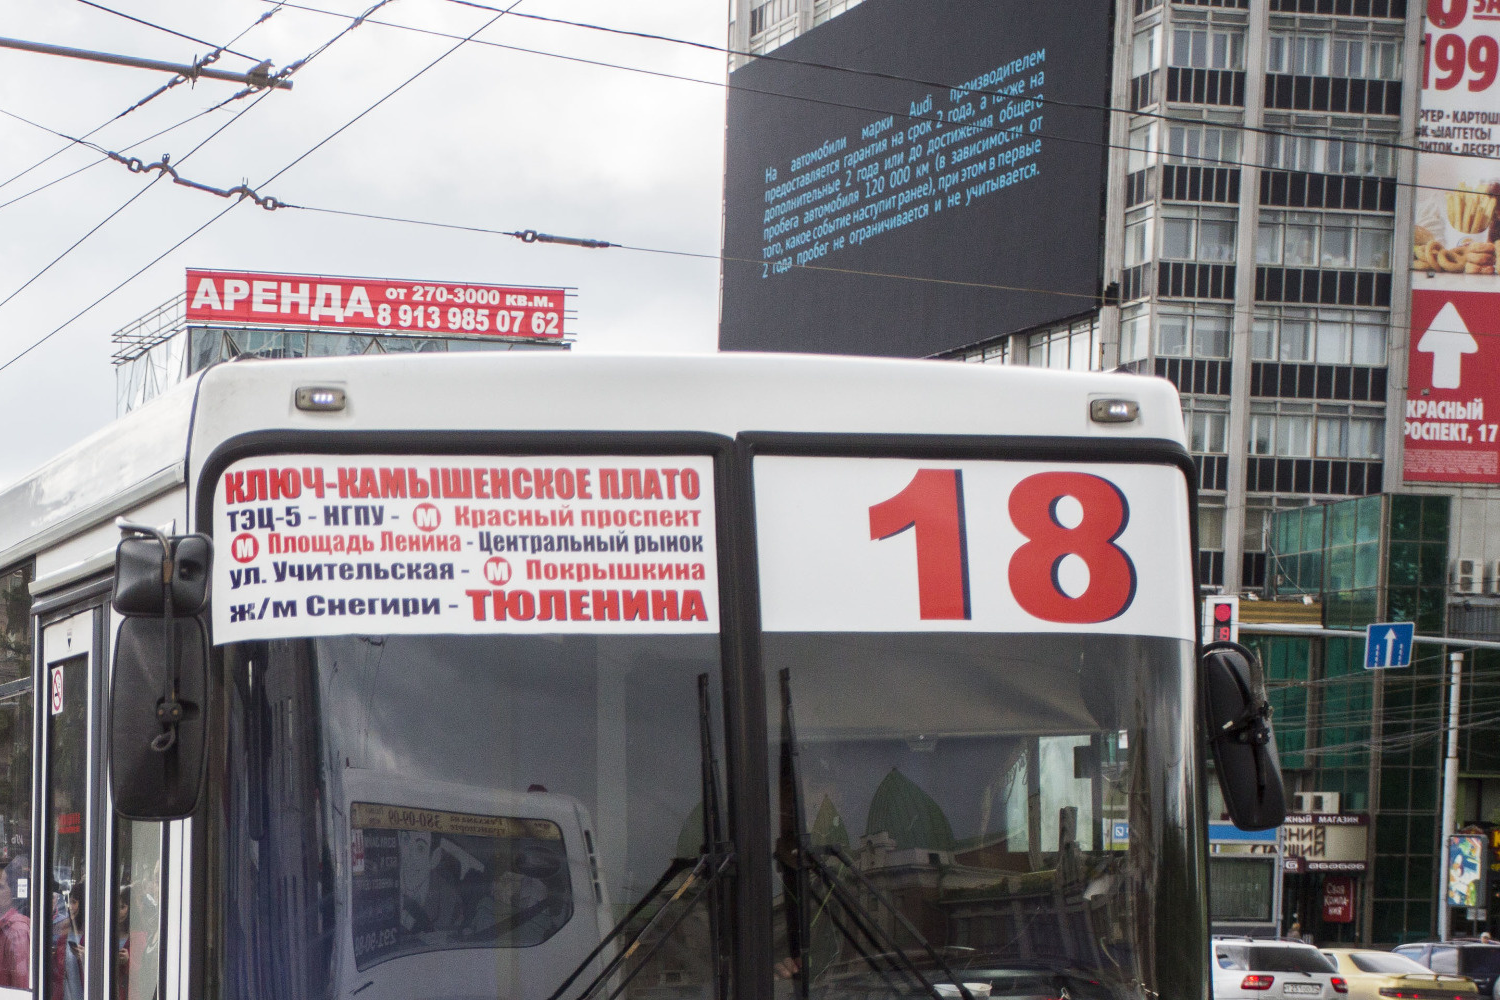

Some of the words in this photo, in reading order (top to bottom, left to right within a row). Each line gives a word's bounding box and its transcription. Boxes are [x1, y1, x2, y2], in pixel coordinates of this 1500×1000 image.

[765, 168, 778, 184] На
[790, 137, 847, 172] автомобили
[861, 116, 893, 140] марки
[908, 95, 933, 117] Audi
[949, 49, 1046, 103] производителем
[764, 160, 840, 204] предоставляется
[843, 138, 888, 169] гарантия
[890, 131, 904, 148] на
[906, 121, 932, 143] срок
[935, 109, 944, 129] 2
[947, 102, 976, 123] года,
[979, 95, 988, 112] а
[991, 79, 1025, 110] также
[1029, 71, 1045, 90] на
[764, 179, 841, 223] дополнительные
[844, 169, 853, 188] 2
[856, 162, 880, 182] года
[883, 152, 904, 171] или
[907, 143, 923, 164] до
[926, 114, 994, 155] достижения
[998, 93, 1044, 124] общего
[763, 215, 799, 242] пробега
[803, 191, 860, 225] автомобиля
[864, 175, 885, 199] 120
[888, 165, 911, 189] 000
[915, 162, 930, 181] км
[934, 152, 946, 173] (в
[951, 125, 1023, 165] зависимости
[1028, 115, 1044, 134] от
[762, 242, 784, 259] того,
[784, 230, 812, 251] какое
[812, 214, 851, 240] событие
[852, 195, 897, 223] наступит
[897, 177, 936, 206] ранее),
[937, 171, 960, 193] при
[960, 160, 987, 183] этом
[987, 156, 996, 172] в
[996, 139, 1042, 167] первые
[761, 263, 769, 279] 2
[771, 256, 793, 274] года
[796, 241, 829, 265] пробег
[832, 236, 845, 251] не
[849, 204, 929, 245] ограничивается
[933, 199, 942, 213] и
[946, 191, 961, 208] не
[965, 163, 1040, 206] учитывается.
[190, 277, 375, 323] АРЕНДА
[385, 288, 407, 301] от
[412, 285, 501, 305] 270-3000
[505, 293, 554, 308] кв.м.
[377, 303, 392, 327] 8
[398, 304, 442, 329] 913
[447, 307, 490, 332] 985
[496, 309, 525, 333] 07
[531, 310, 560, 335] 62
[1406, 397, 1484, 420] КРАСНЫЙ
[1478, 423, 1499, 443] 17
[224, 467, 592, 505] КЛЮЧ-КАМЫШЕНСКОЕ
[599, 467, 701, 501] ПЛАТО
[226, 505, 302, 533] ТЭЦ-5
[323, 504, 385, 528] НГПУ
[454, 505, 574, 529] Красный
[581, 507, 702, 530] проспект
[267, 532, 376, 558] Площадь
[379, 530, 462, 554] Ленина
[478, 531, 630, 556] Центральный
[633, 533, 705, 556] рынок
[868, 468, 1138, 624] 18
[229, 563, 267, 591] ул.
[273, 561, 456, 585] Учительская
[525, 559, 706, 583] Покрышкина
[229, 597, 298, 622] ж/м
[305, 595, 442, 618] Снегири
[465, 588, 709, 623] ТЮЛЕНИНА
[1318, 815, 1359, 824] МАГАЗИН
